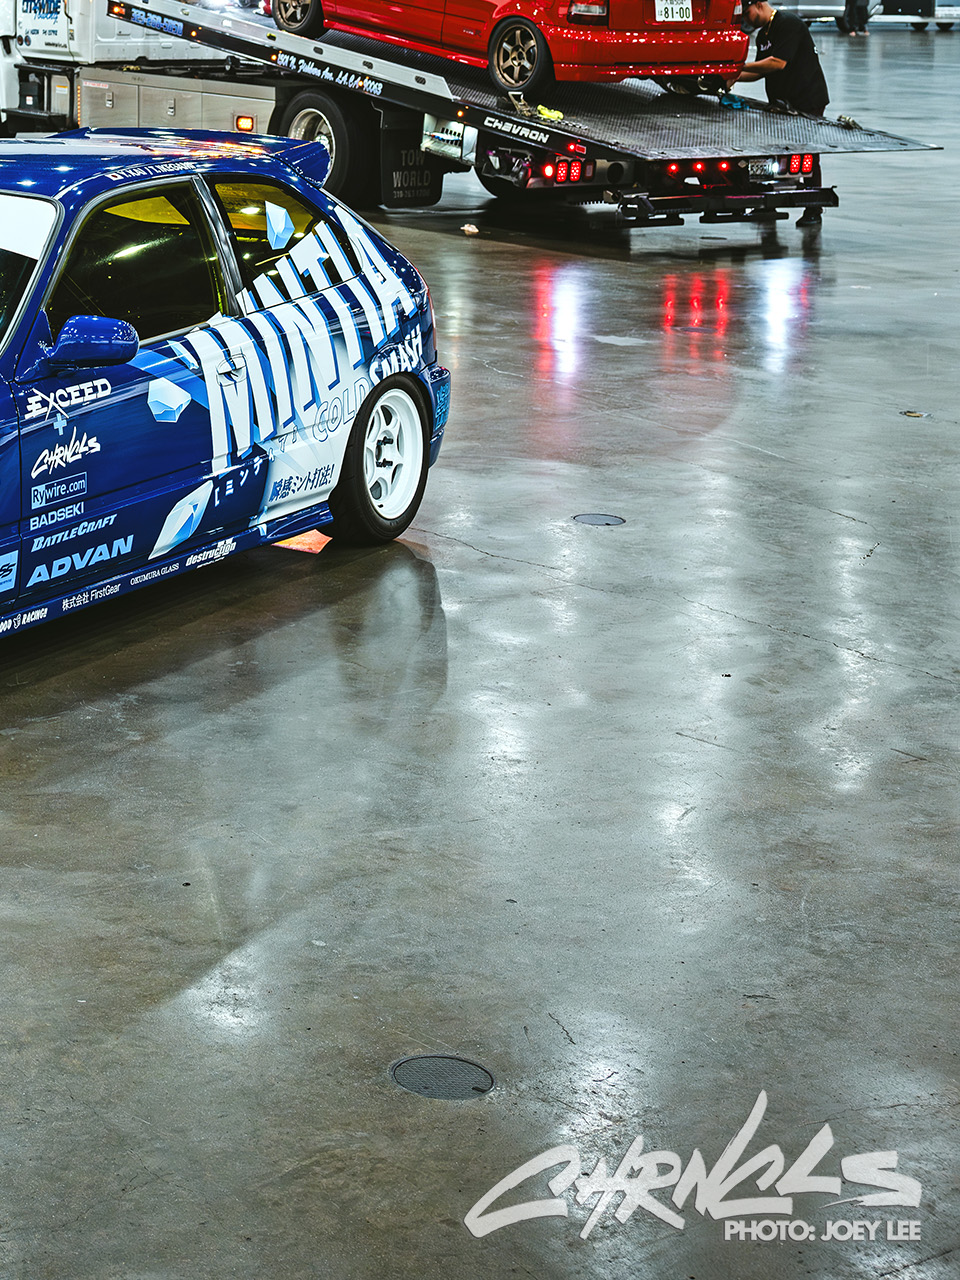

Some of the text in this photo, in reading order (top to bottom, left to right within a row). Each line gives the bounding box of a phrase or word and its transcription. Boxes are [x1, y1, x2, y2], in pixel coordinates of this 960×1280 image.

[664, 6, 690, 19] 81-00
[483, 116, 550, 143] CHEVRON
[401, 149, 425, 166] TOW
[393, 170, 431, 188] WORLD
[184, 205, 418, 475] MINTIA
[24, 378, 112, 421] EXCEED
[32, 478, 86, 506] Rywire.com
[29, 501, 85, 531] BADSEKI
[25, 534, 135, 588] ADVAN
[129, 563, 180, 586] OKUMURA GLASS
[61, 583, 122, 612] 株式会社 FirstGear
